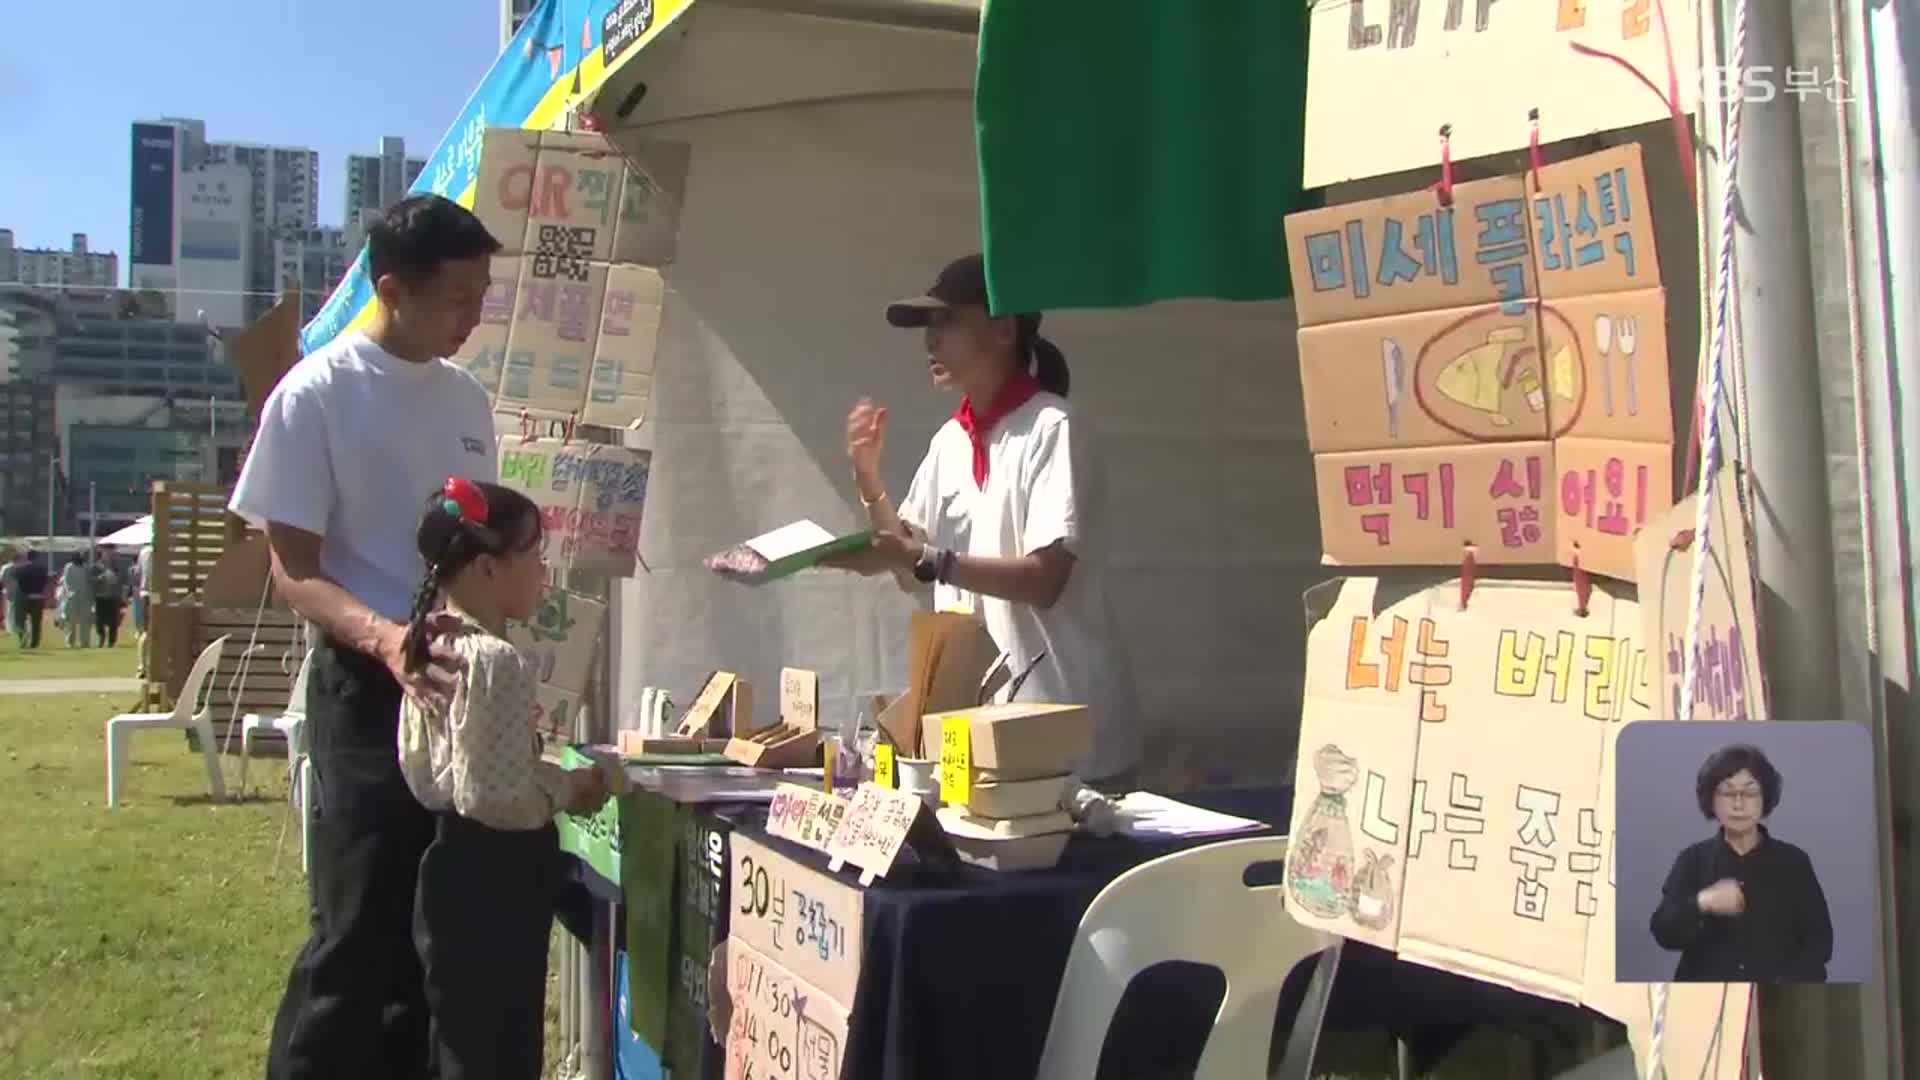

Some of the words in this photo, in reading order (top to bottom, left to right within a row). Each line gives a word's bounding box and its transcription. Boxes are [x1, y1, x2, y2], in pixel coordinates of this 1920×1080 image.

[1344, 462, 1455, 545] 먹기
[1345, 616, 1453, 723] 너는
[1360, 770, 1485, 872] 나는
[1508, 783, 1616, 922] 줍는
[740, 856, 786, 951] 30분
